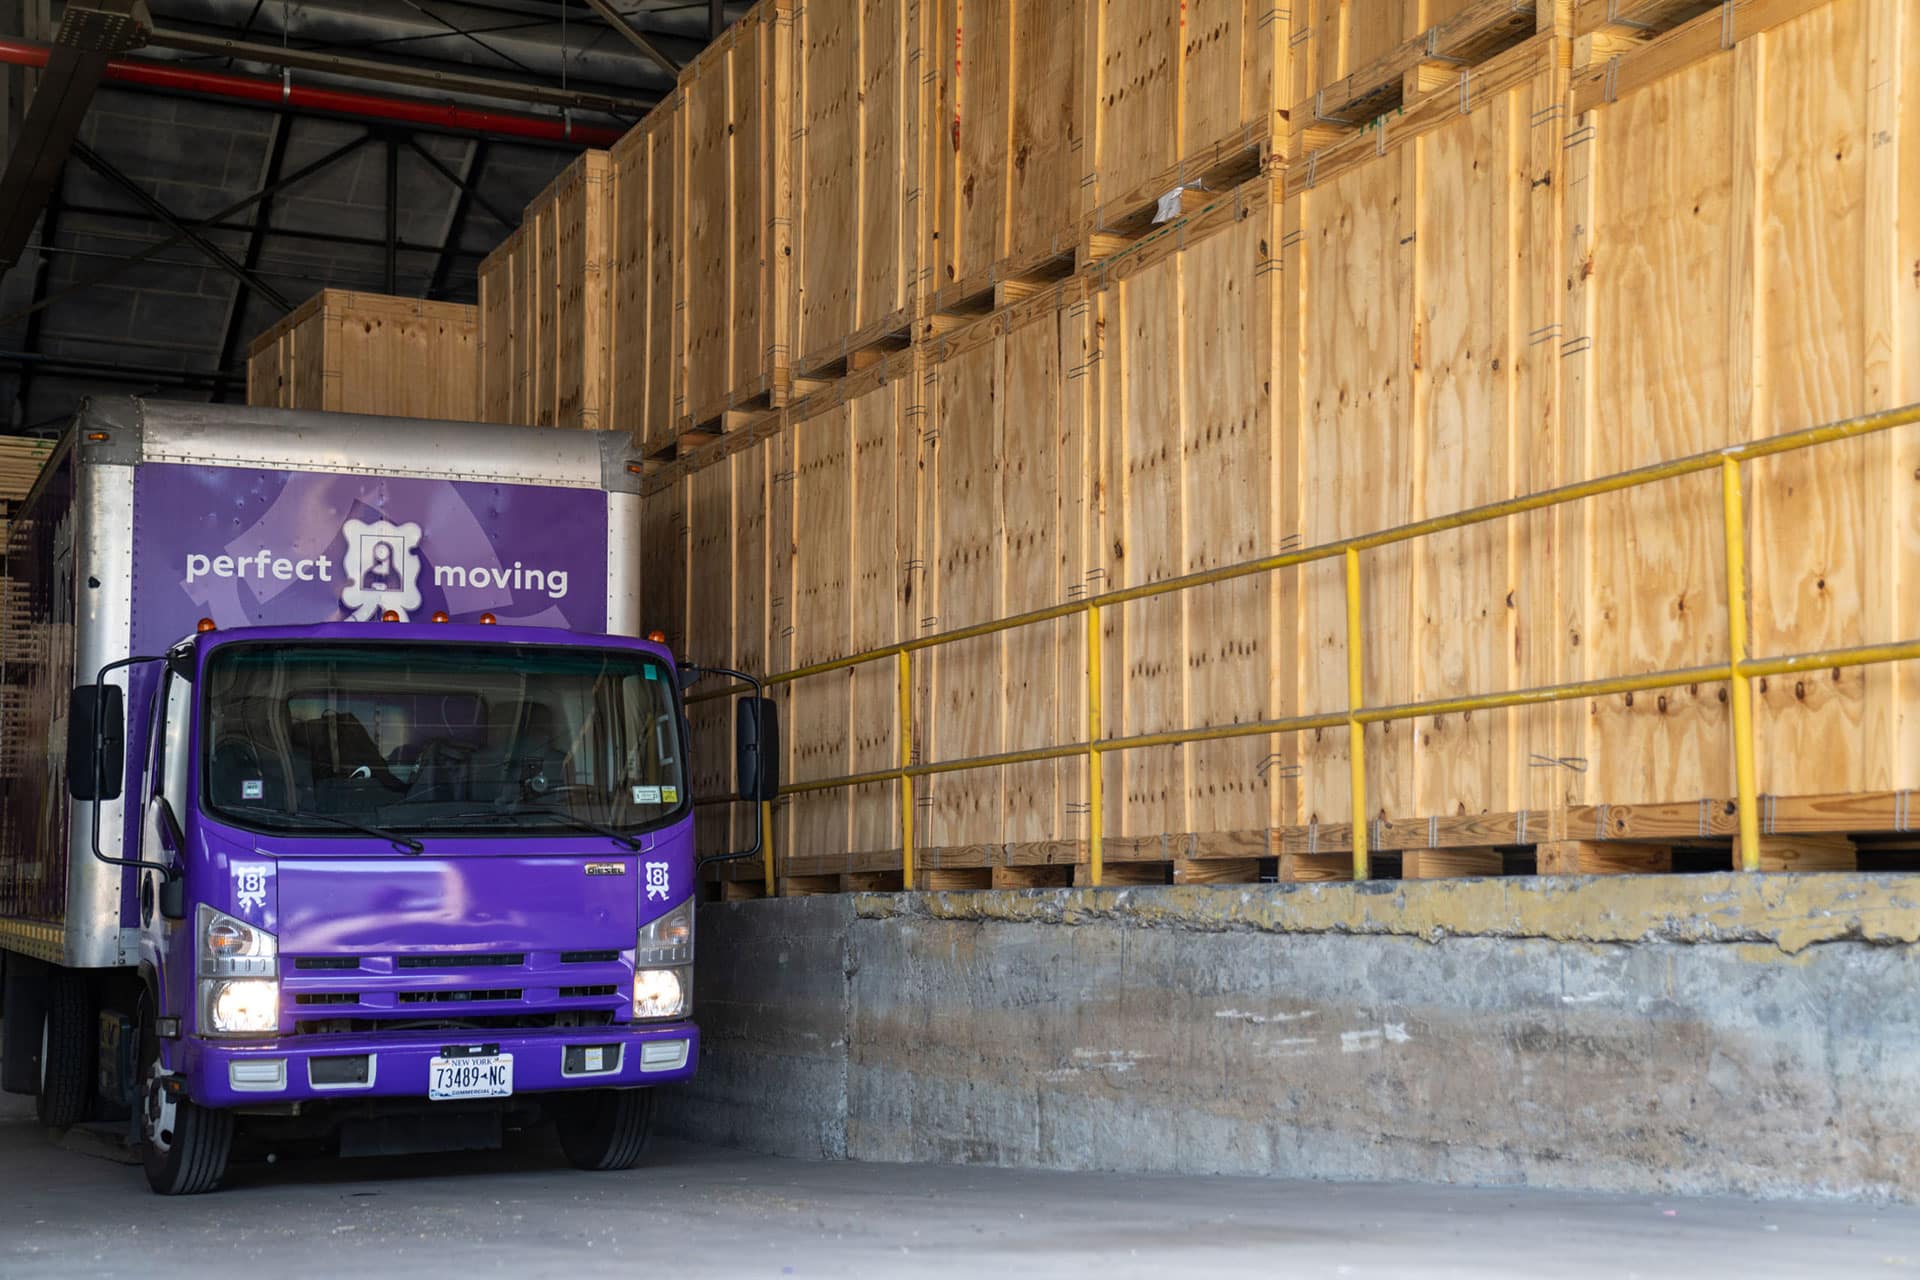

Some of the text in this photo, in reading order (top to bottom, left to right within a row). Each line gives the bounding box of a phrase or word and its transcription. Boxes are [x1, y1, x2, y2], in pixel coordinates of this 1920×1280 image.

[186, 550, 568, 598] perfect moving
[246, 873, 258, 890] 8
[652, 868, 663, 885] 8
